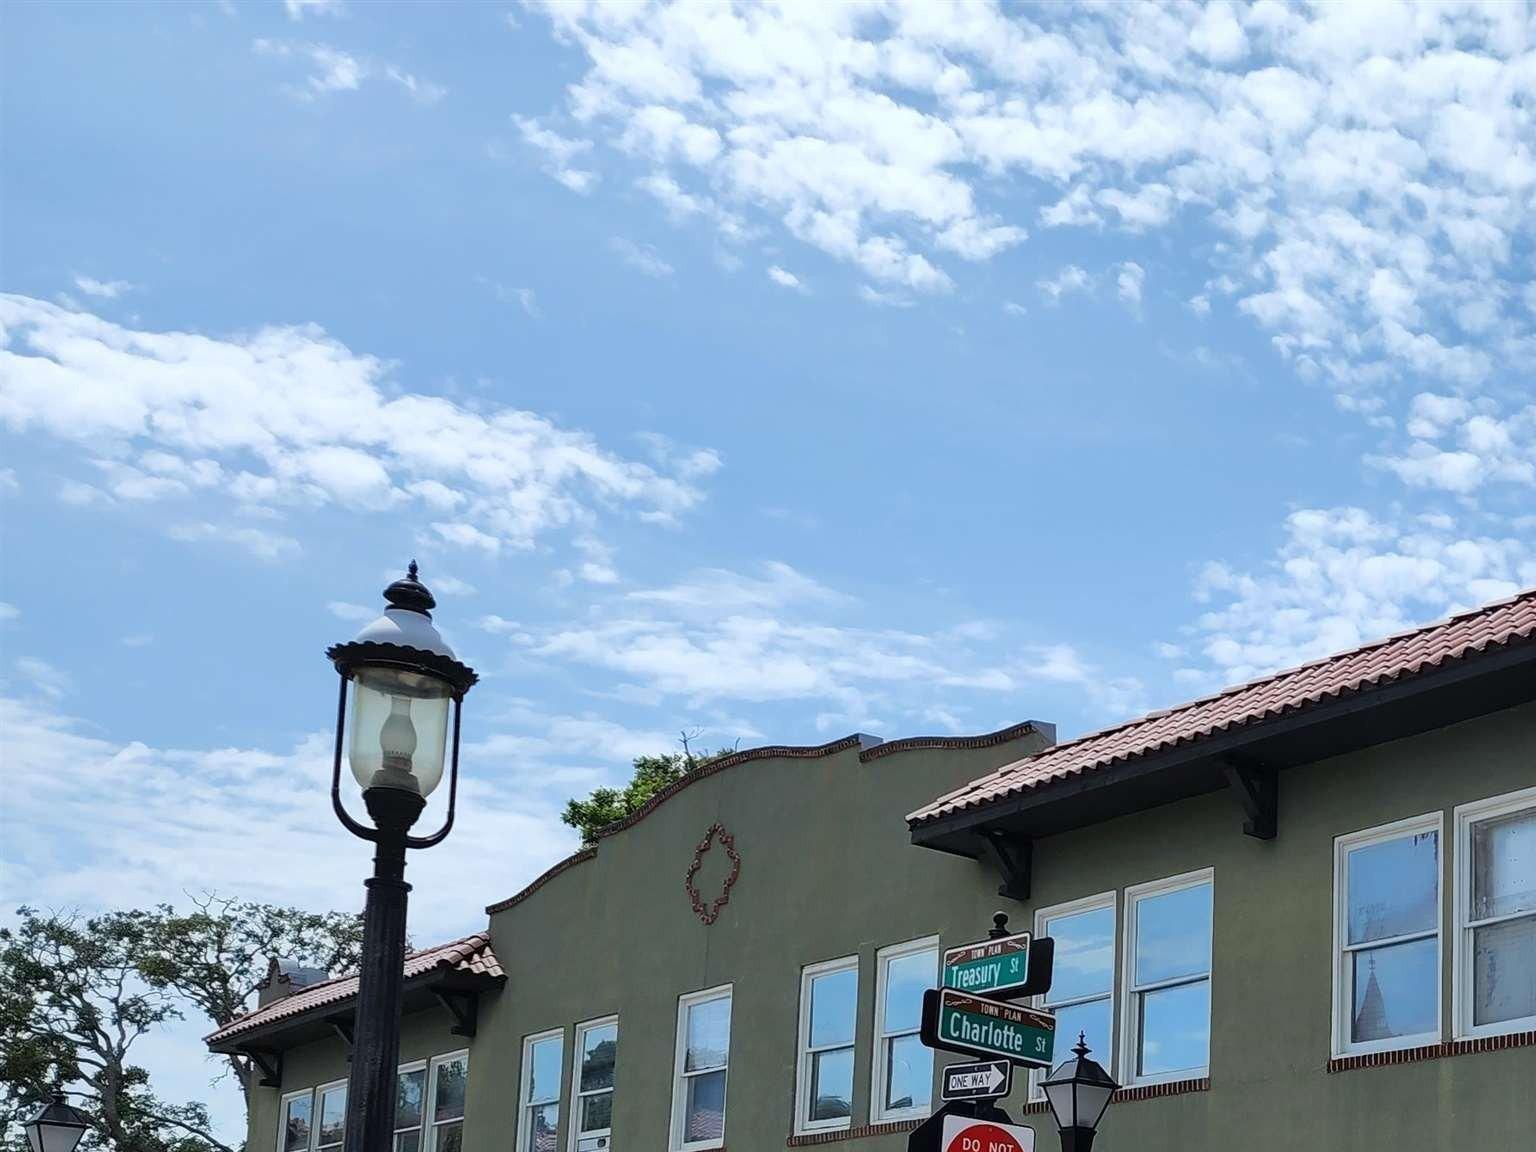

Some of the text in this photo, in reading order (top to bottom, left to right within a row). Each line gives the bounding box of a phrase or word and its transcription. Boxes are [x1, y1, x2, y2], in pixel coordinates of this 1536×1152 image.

[971, 944, 1001, 960] TOWN PLAN
[952, 957, 1019, 988] Treasury St
[980, 1003, 1021, 1022] TOWN PLAN
[950, 1011, 1046, 1053] Charlotte St
[951, 1073, 992, 1089] ONE WAY
[962, 1137, 981, 1152] DO
